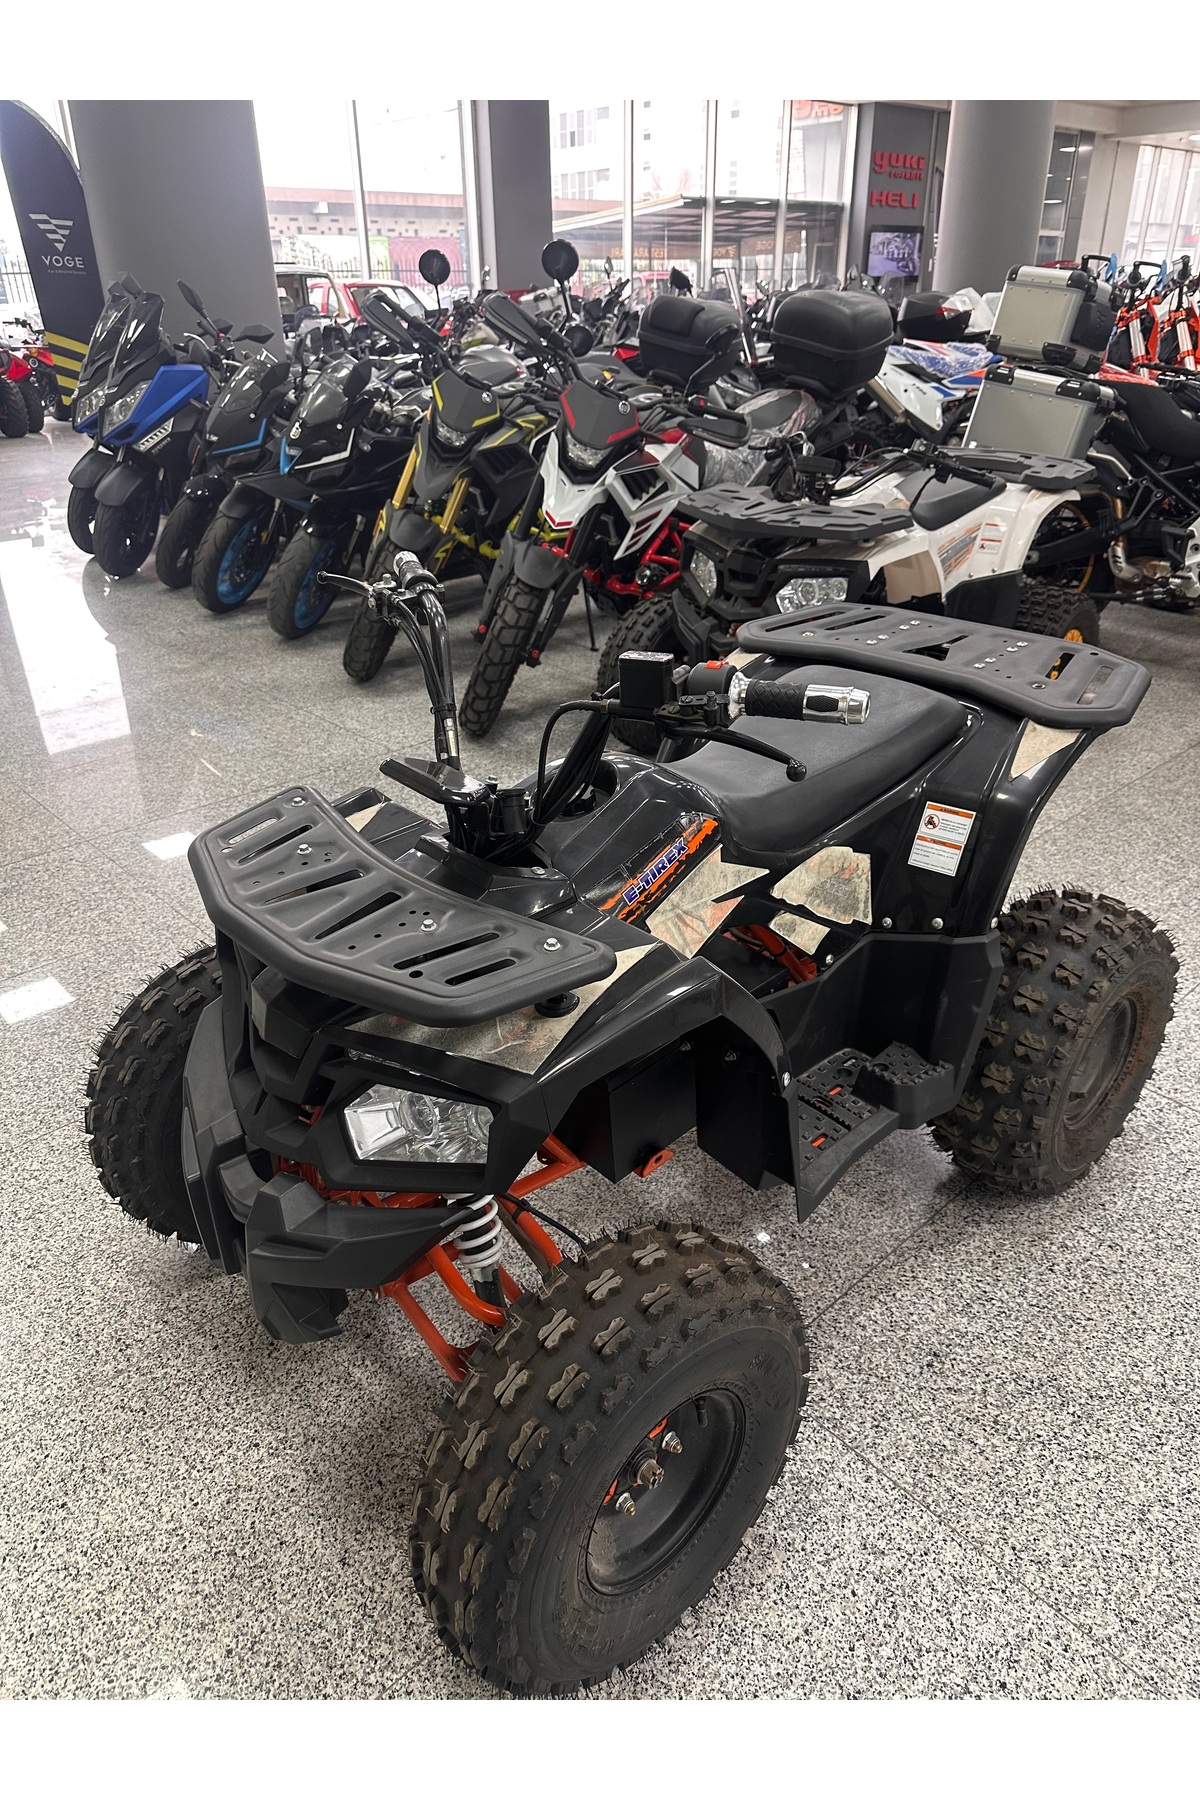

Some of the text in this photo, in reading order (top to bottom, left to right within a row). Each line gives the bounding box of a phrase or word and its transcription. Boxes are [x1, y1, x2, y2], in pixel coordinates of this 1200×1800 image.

[870, 190, 919, 209] HELI
[41, 255, 85, 268] VOGE
[622, 836, 689, 906] E-TIREX
